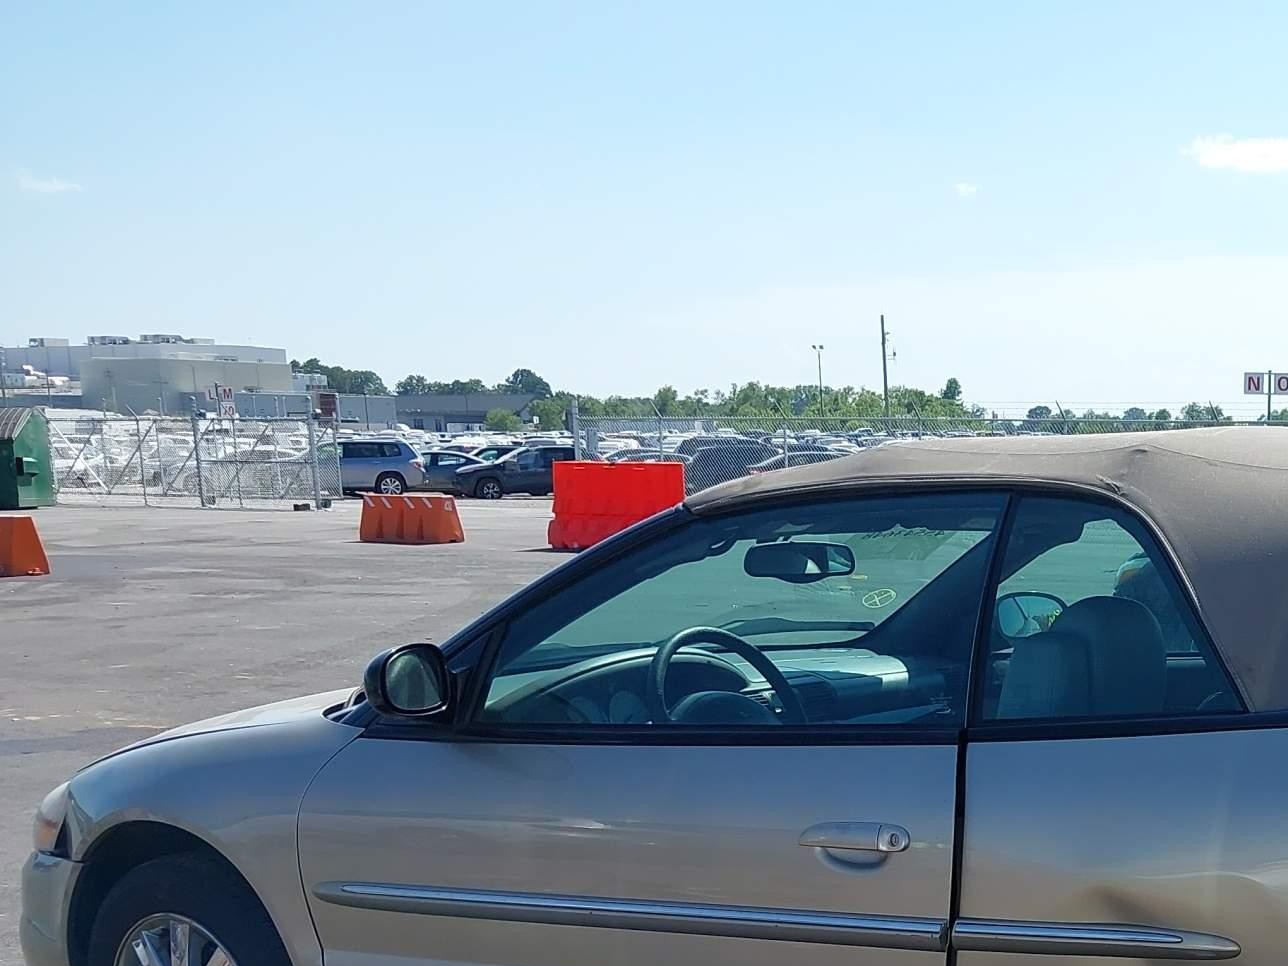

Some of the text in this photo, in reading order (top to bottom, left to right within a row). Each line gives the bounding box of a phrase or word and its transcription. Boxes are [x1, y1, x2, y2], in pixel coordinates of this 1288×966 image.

[1248, 376, 1260, 391] N
[208, 388, 233, 400] L M
